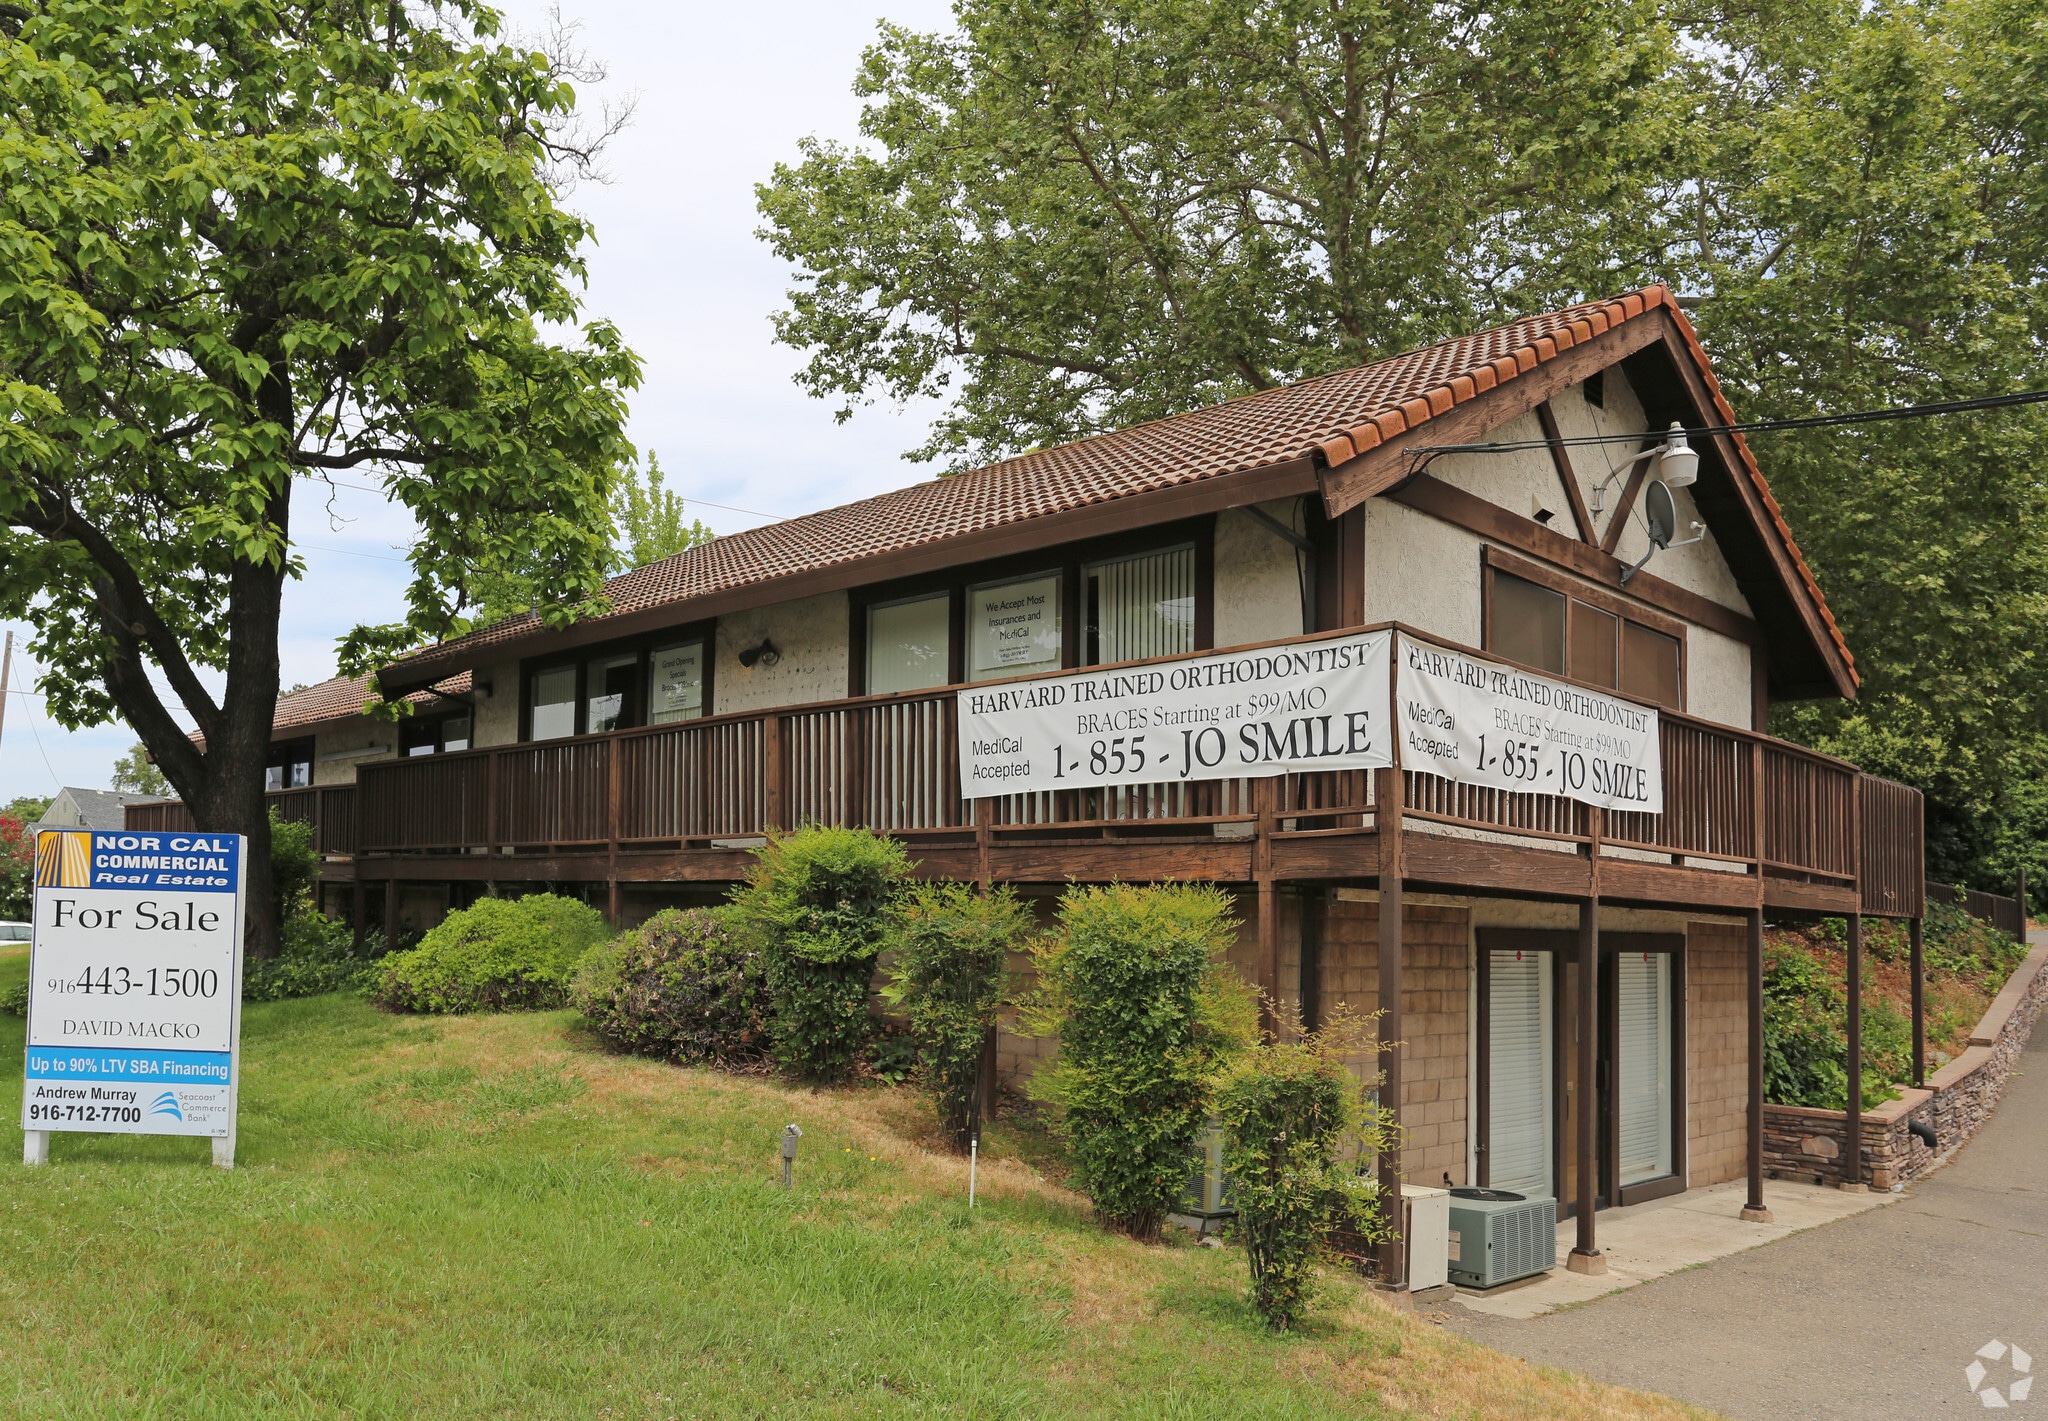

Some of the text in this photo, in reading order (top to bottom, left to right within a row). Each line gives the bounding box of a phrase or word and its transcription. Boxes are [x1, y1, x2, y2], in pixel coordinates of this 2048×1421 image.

[986, 595, 1045, 613] We Accept Most
[989, 610, 1041, 627] Insurances and
[1000, 627, 1030, 640] MediCal
[971, 643, 1371, 715] HARVARD TRAINED ORTHODONTIST
[1408, 645, 1648, 734] HARVARD TRAINED ORTHODONTIST
[1077, 686, 1327, 735] BRACES Starting at $99/MO
[1408, 700, 1455, 731] MediCal
[1494, 707, 1631, 760] BRACES Starting at $99/MO
[972, 737, 1023, 757] MediCal
[1089, 734, 1146, 776] 855
[1180, 727, 1226, 778] JO
[1239, 711, 1371, 763] SMILE
[1408, 730, 1459, 761] Accepted
[972, 760, 1030, 781] Accepted
[1503, 739, 1539, 782] 855
[1559, 750, 1586, 795] JO
[1592, 757, 1648, 802] SMILE
[96, 836, 230, 853] NOR CAL
[96, 855, 229, 872] COMMERCIAL
[95, 873, 229, 887] Real Estate
[51, 899, 220, 932] For Sale
[62, 1019, 200, 1039] DAVID MACKO
[31, 1056, 229, 1080] Up to 90% LTV SBA Financing
[35, 1086, 137, 1104] Andrew Murray
[178, 1091, 216, 1101] Seacoast
[30, 1104, 141, 1123] 916-712-7700
[181, 1102, 227, 1112] Commerce
[187, 1113, 207, 1122] Bank
